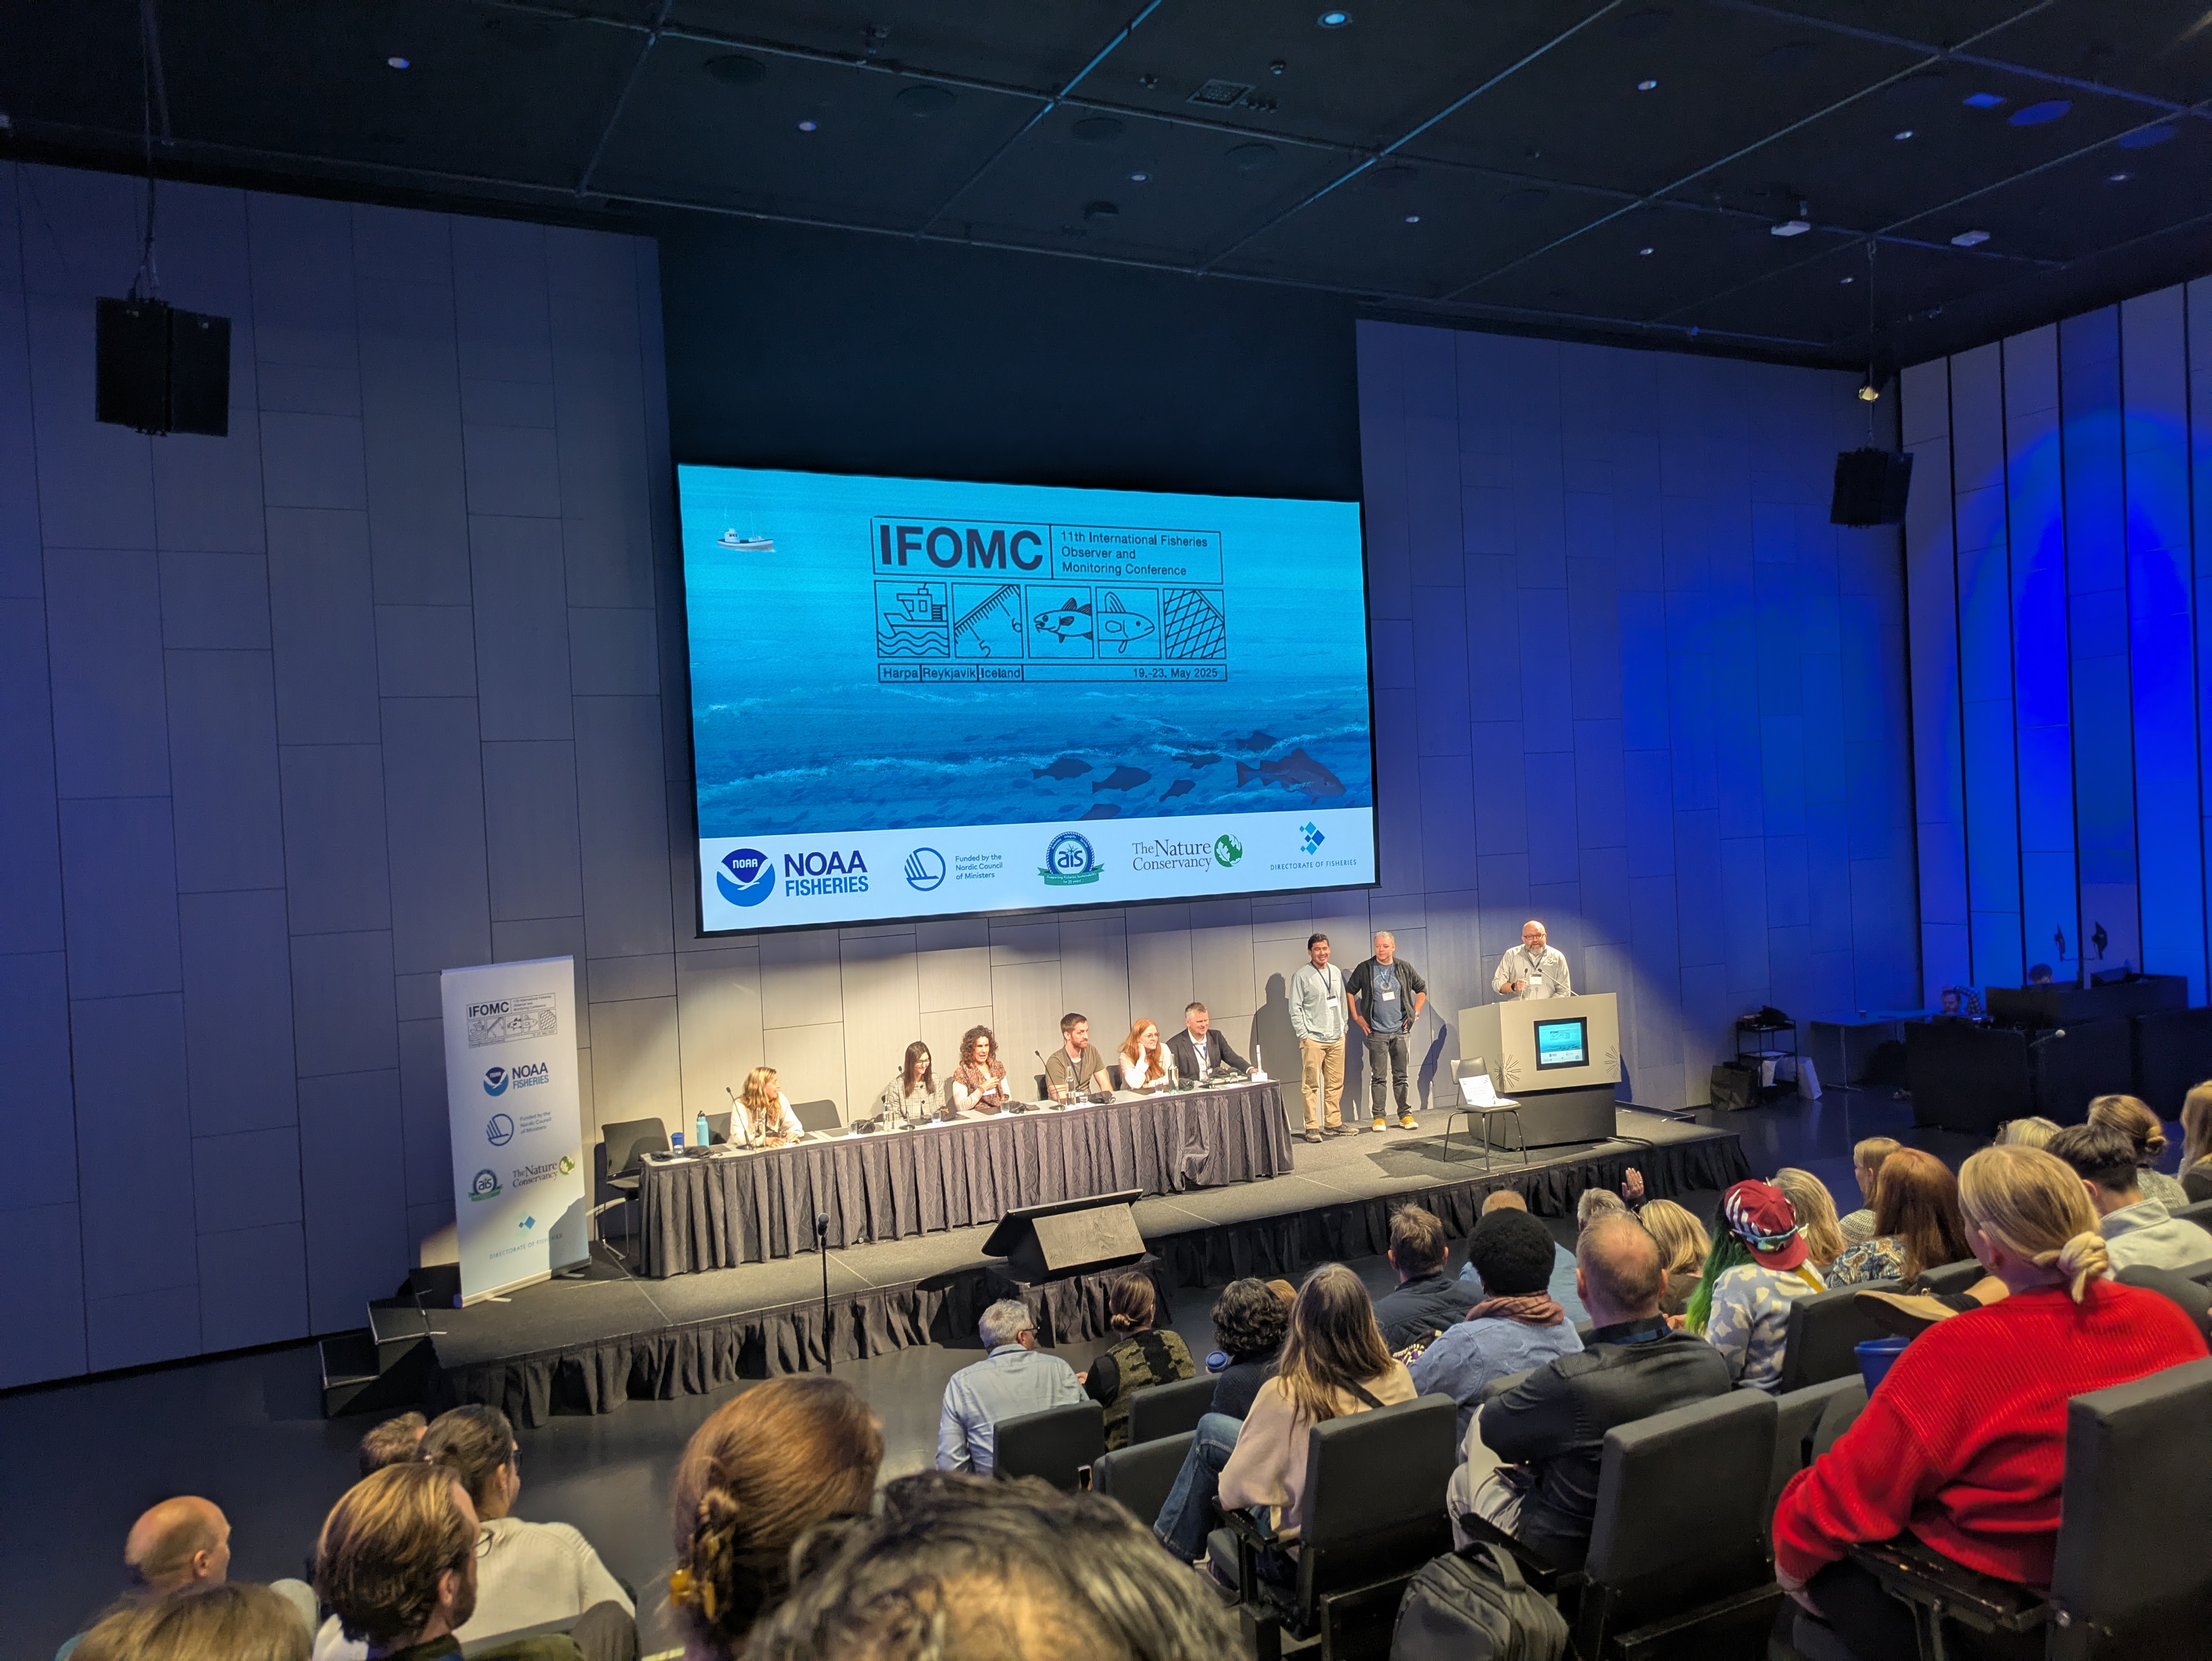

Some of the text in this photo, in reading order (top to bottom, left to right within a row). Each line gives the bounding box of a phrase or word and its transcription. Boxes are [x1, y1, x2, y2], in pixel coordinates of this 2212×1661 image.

[1061, 531, 1208, 547] 11th International Fisheries
[880, 524, 1043, 570] IFOMC
[1062, 546, 1136, 559] Observer and
[1062, 562, 1187, 576] Monitoring Conference
[884, 667, 918, 680] Harpa
[981, 667, 1020, 678] Iceland
[1133, 668, 1217, 680] 19.-23. May 2025
[1132, 839, 1212, 857] The Nature
[732, 858, 758, 869] NOAA
[784, 850, 868, 877] NOAA
[1133, 857, 1212, 872] Conservancy
[1271, 862, 1313, 870] DIRECTORATE
[785, 875, 869, 897] FISHERIES
[469, 1001, 509, 1018] IFOMC
[512, 1062, 548, 1080] NOAA
[512, 1075, 549, 1089] FISHERIES
[512, 1162, 558, 1178] The Nature
[478, 1178, 492, 1190] ais
[512, 1172, 558, 1187] Conservancy
